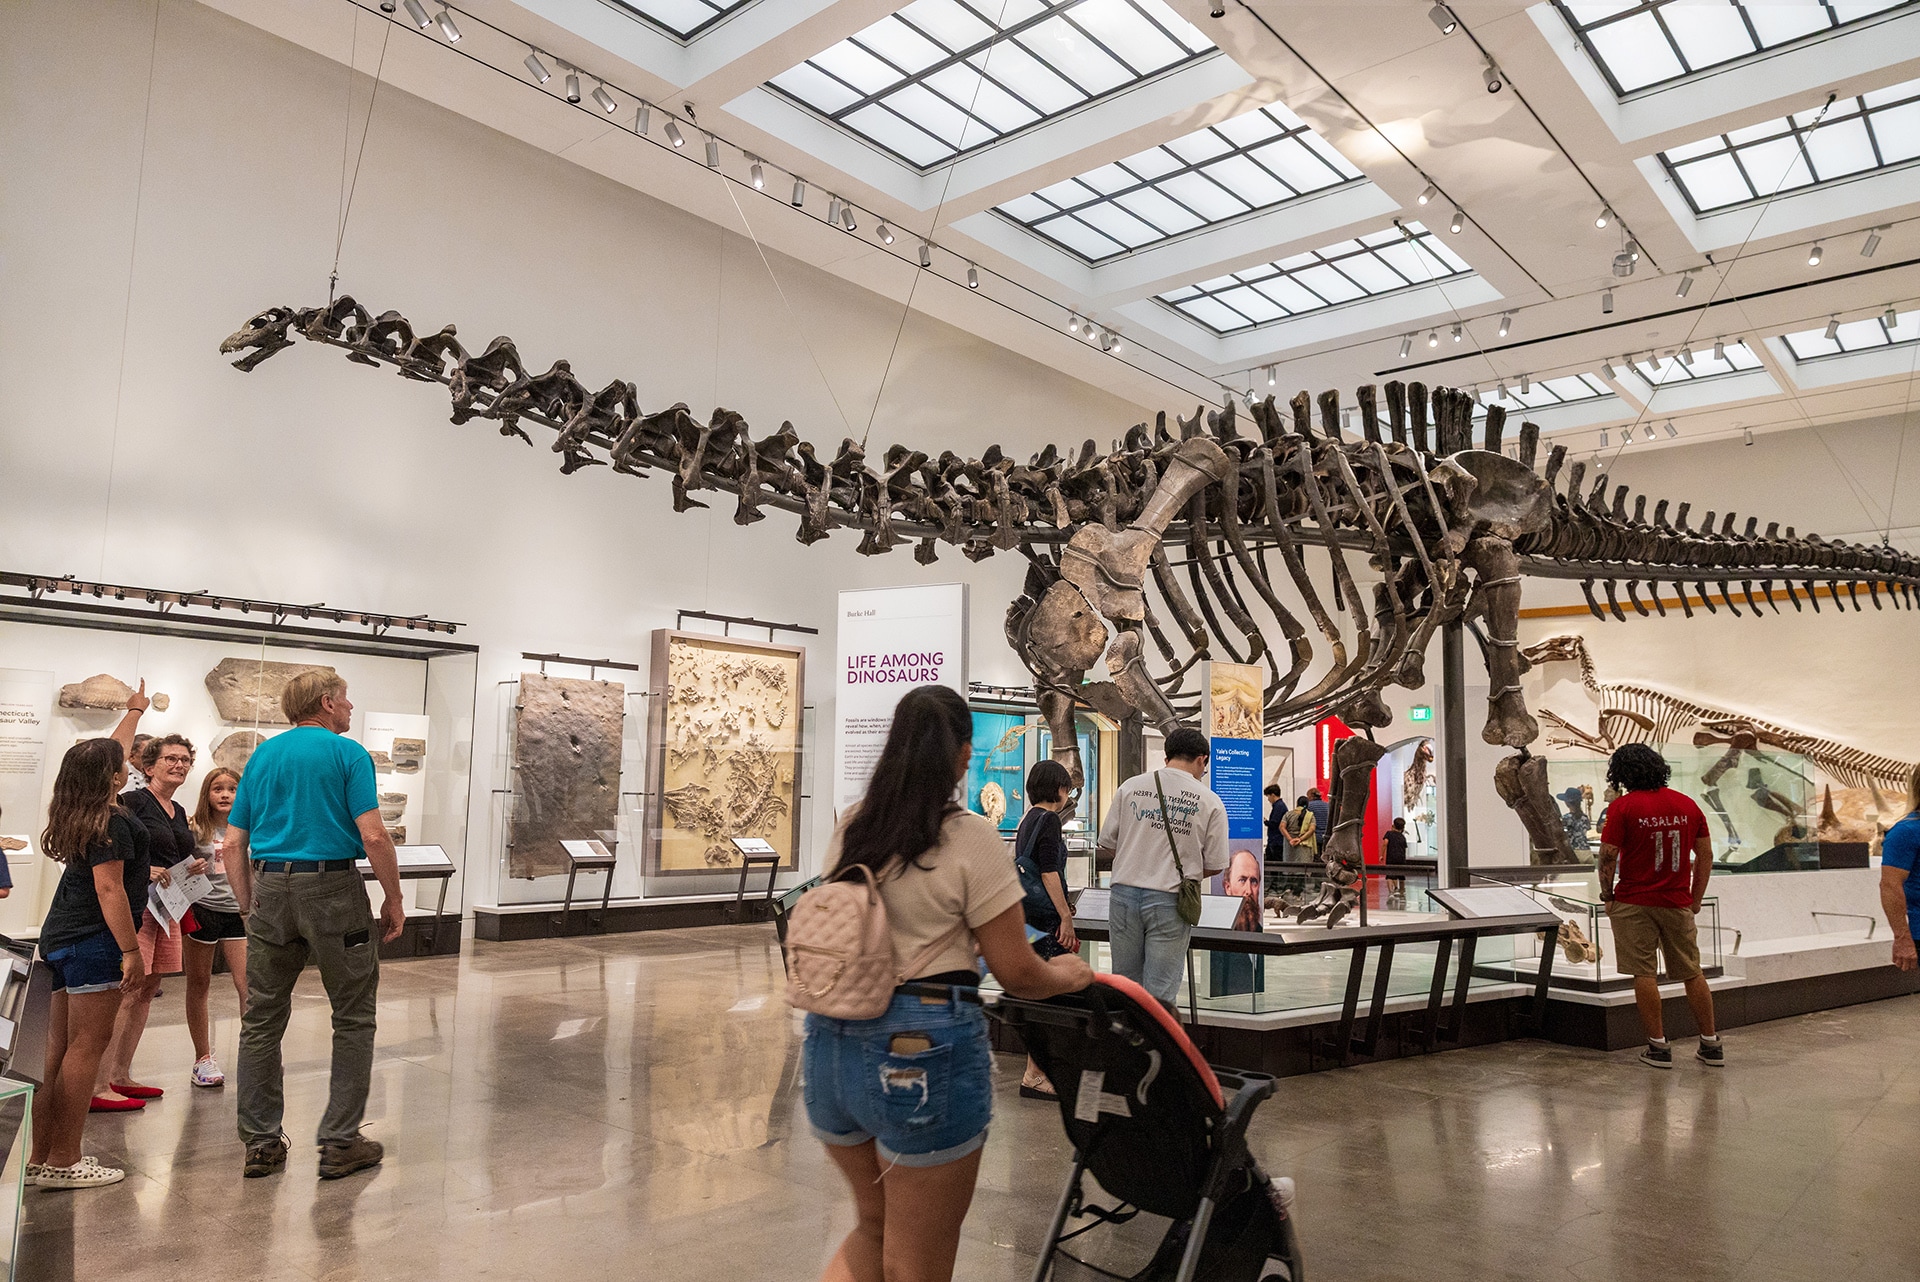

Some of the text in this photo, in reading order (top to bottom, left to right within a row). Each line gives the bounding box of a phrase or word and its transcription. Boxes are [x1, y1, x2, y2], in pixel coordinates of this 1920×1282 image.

[847, 610, 863, 618] Burke
[848, 652, 944, 668] LIFE AMONG
[847, 668, 939, 684] DINOSAURS
[1638, 815, 1688, 828] M.SALAH
[1650, 829, 1680, 872] 11
